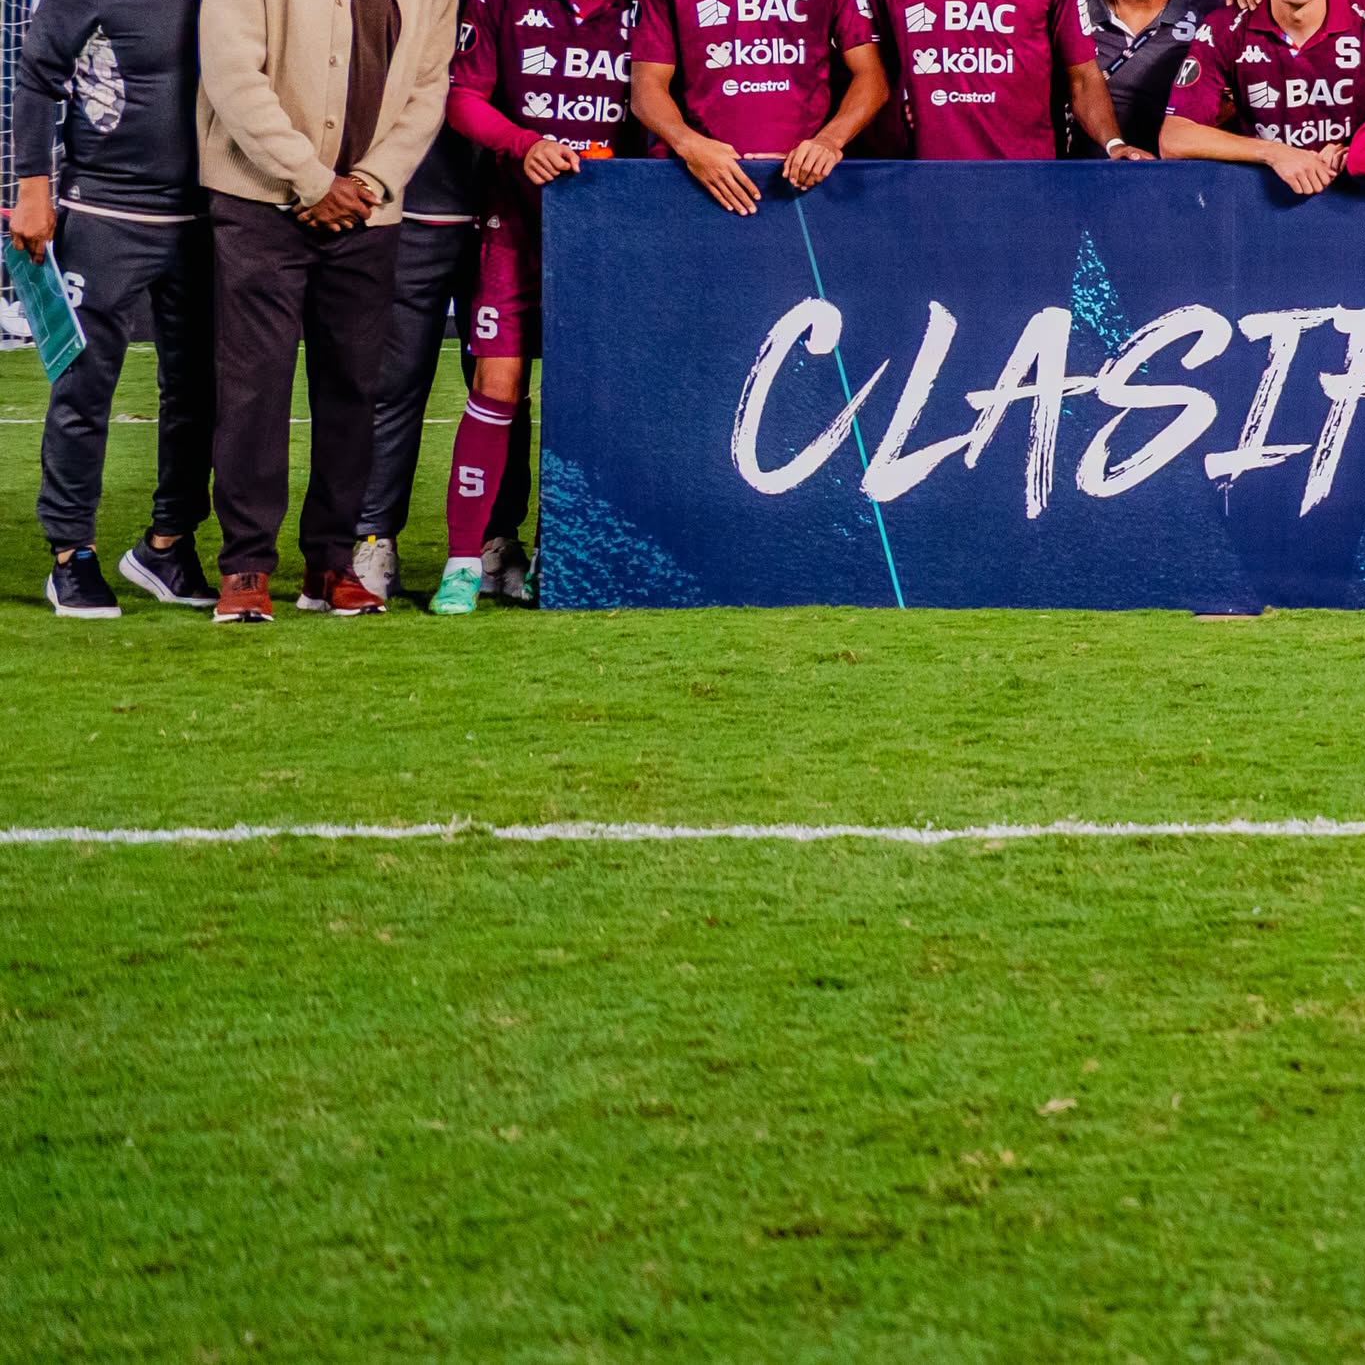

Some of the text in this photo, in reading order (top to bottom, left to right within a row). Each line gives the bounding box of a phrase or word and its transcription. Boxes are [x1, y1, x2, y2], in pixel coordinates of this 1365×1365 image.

[944, 1, 1016, 33] BAC
[735, 38, 805, 65] kölbi
[943, 47, 1014, 74] kölbi
[1335, 36, 1361, 69] S
[740, 80, 790, 93] Castrol
[949, 91, 995, 104] Castrol
[1286, 79, 1354, 108] BAC
[1284, 117, 1351, 147] kölbi
[476, 306, 500, 339] S
[459, 467, 485, 497] S
